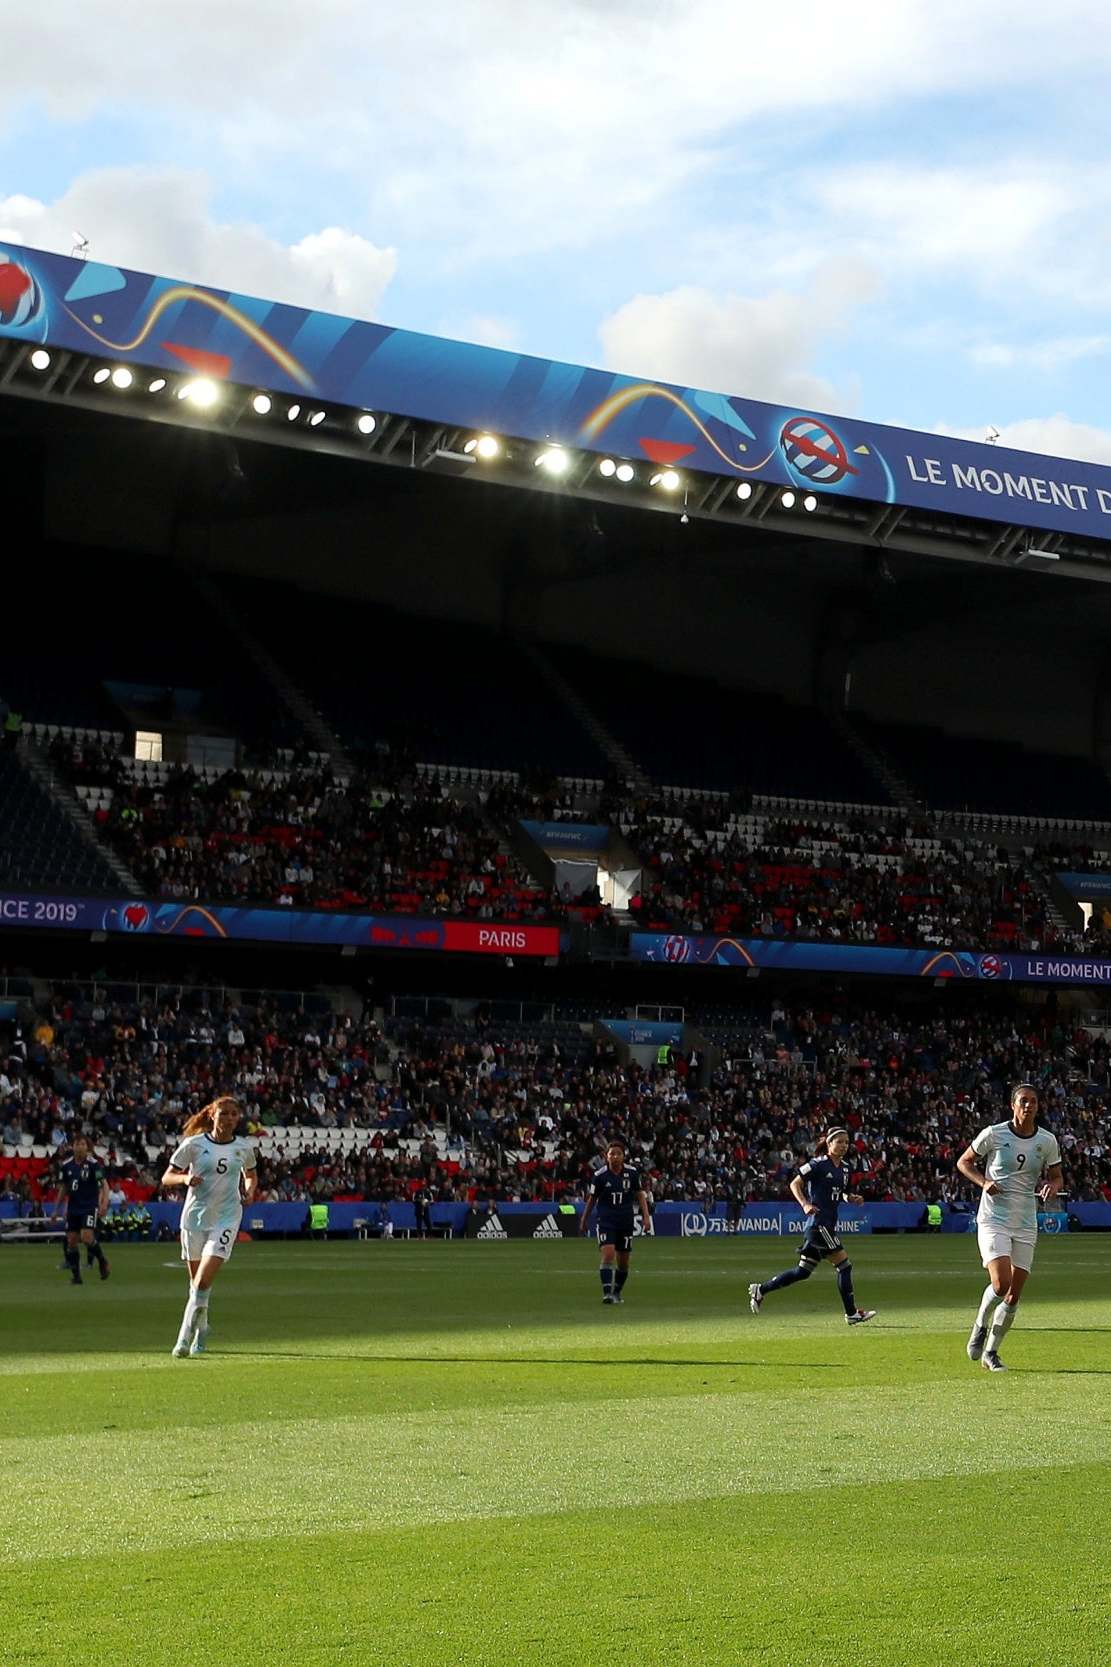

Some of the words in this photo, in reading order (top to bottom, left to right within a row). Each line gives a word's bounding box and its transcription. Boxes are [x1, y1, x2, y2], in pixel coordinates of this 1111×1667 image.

[906, 455, 946, 485] LE
[951, 463, 1089, 510] MOMENT
[0, 900, 29, 918] CE
[479, 930, 526, 948] PARIS
[1027, 961, 1043, 976] LE
[216, 1158, 228, 1174] 5
[1016, 1154, 1026, 1170] 9
[72, 1179, 79, 1191] 6
[611, 1192, 623, 1205] 17
[86, 1215, 94, 1227] 6
[633, 1215, 656, 1236] SA
[834, 1220, 860, 1232] HINE
[219, 1229, 232, 1245] 5
[477, 1231, 507, 1239] adidas
[533, 1230, 563, 1239] adidas
